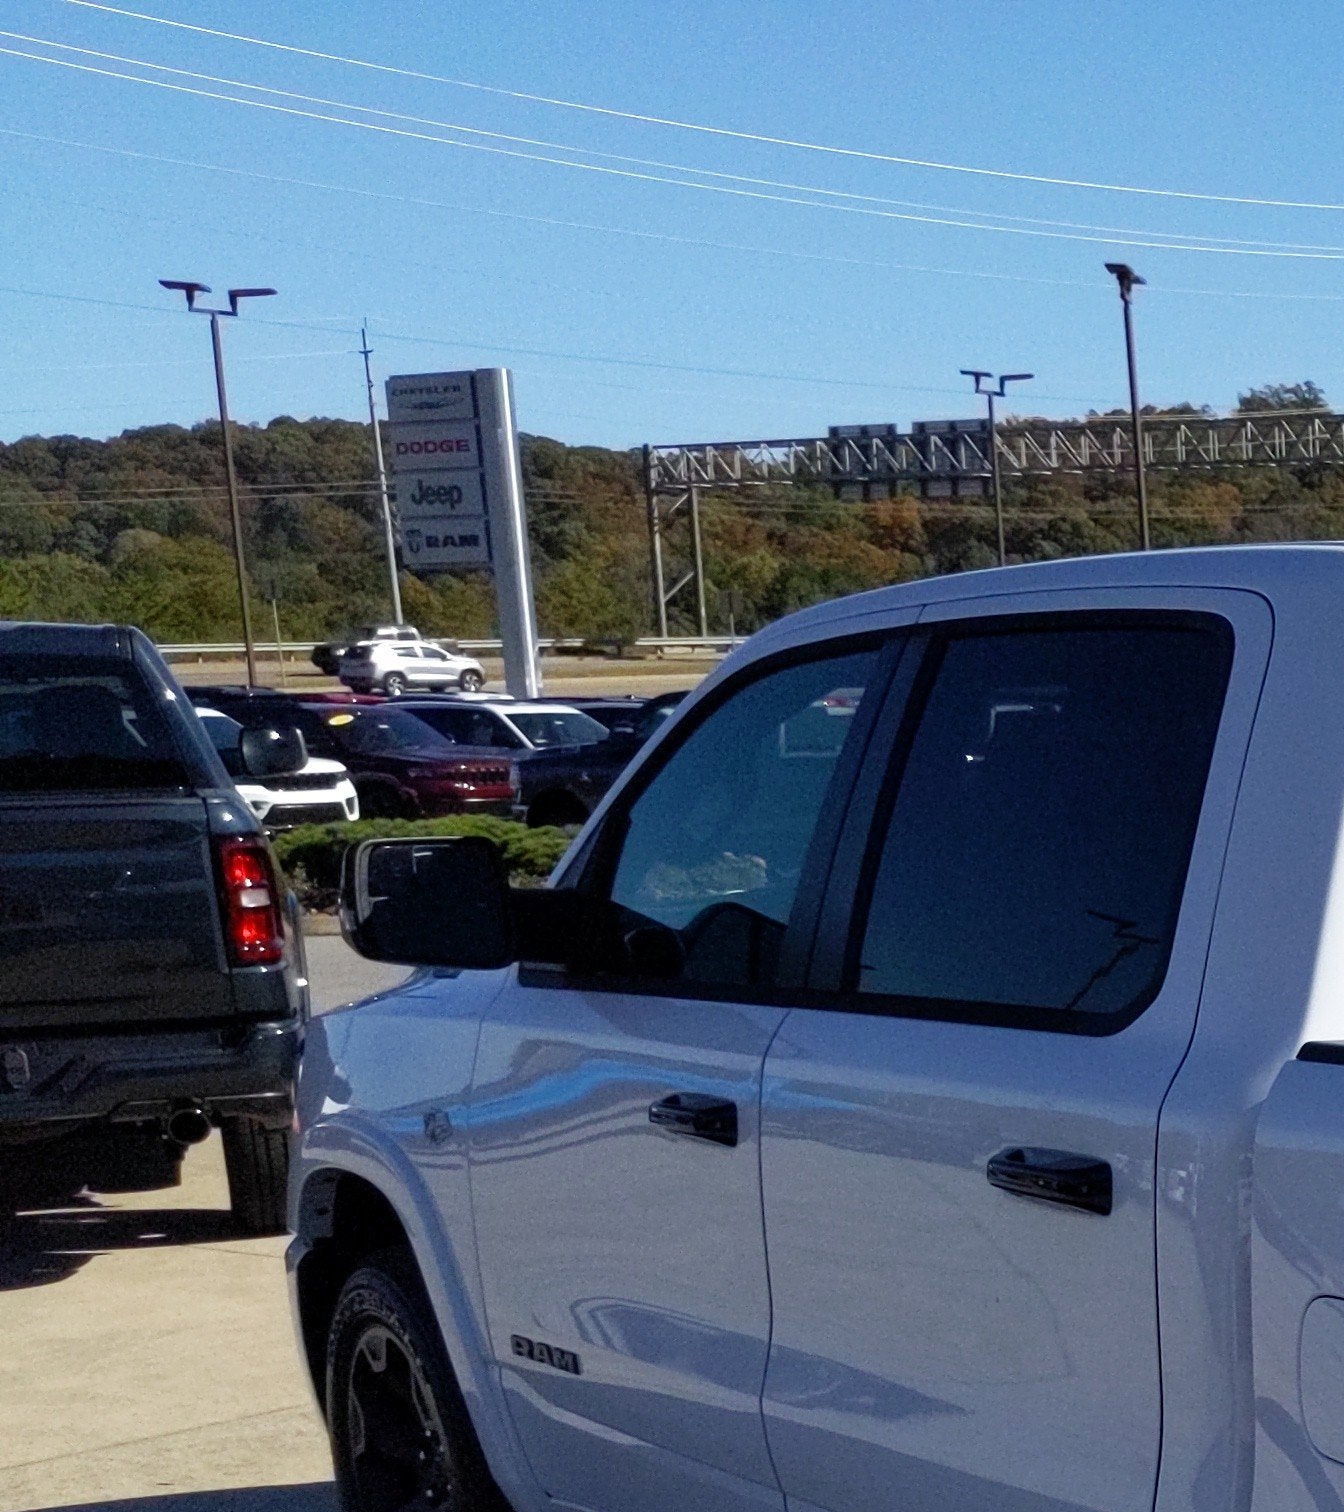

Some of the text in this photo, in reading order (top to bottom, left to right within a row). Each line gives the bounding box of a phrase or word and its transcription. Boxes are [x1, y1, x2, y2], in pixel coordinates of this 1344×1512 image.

[396, 438, 470, 456] DODGE
[410, 478, 463, 510] Jeep
[425, 534, 480, 549] RAM
[511, 1334, 581, 1375] RAM
